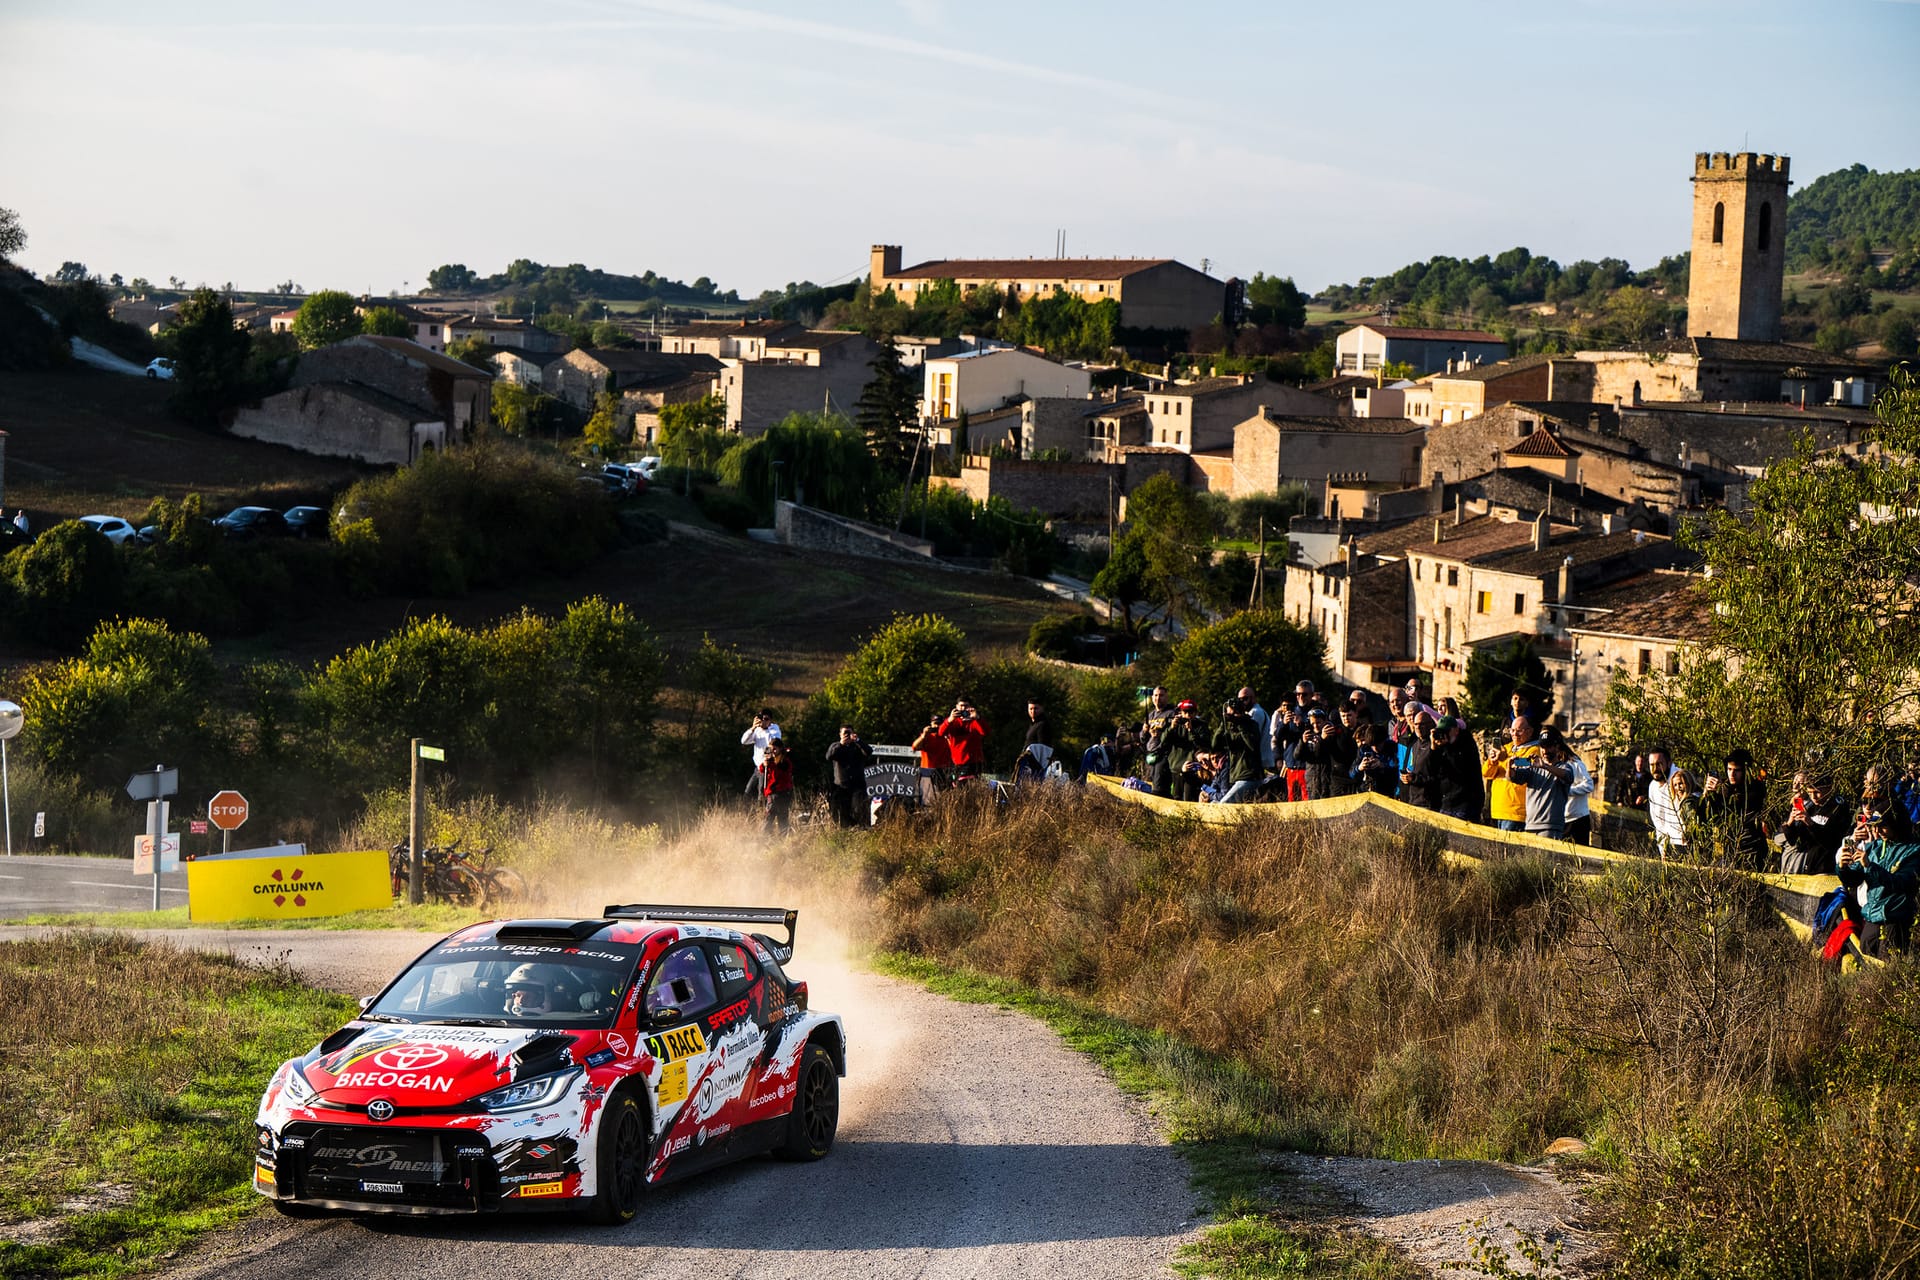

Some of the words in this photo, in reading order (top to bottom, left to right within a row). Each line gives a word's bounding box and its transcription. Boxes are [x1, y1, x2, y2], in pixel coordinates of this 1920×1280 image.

[892, 774, 900, 783] A
[866, 783, 914, 797] CONES
[212, 805, 246, 816] STOP
[253, 881, 324, 894] CATALUNYA
[438, 945, 499, 955] TOYOTA
[501, 944, 562, 953] GAZOO
[564, 948, 626, 962] Racing
[735, 945, 753, 981] 2
[411, 1028, 486, 1037] GRUPO
[402, 1034, 510, 1045] BARREIRO
[650, 1037, 665, 1063] 2
[667, 1028, 702, 1058] RACC
[334, 1072, 454, 1092] BREOGAN
[313, 1147, 355, 1159] ARES
[523, 1183, 560, 1195] PIRELLI
